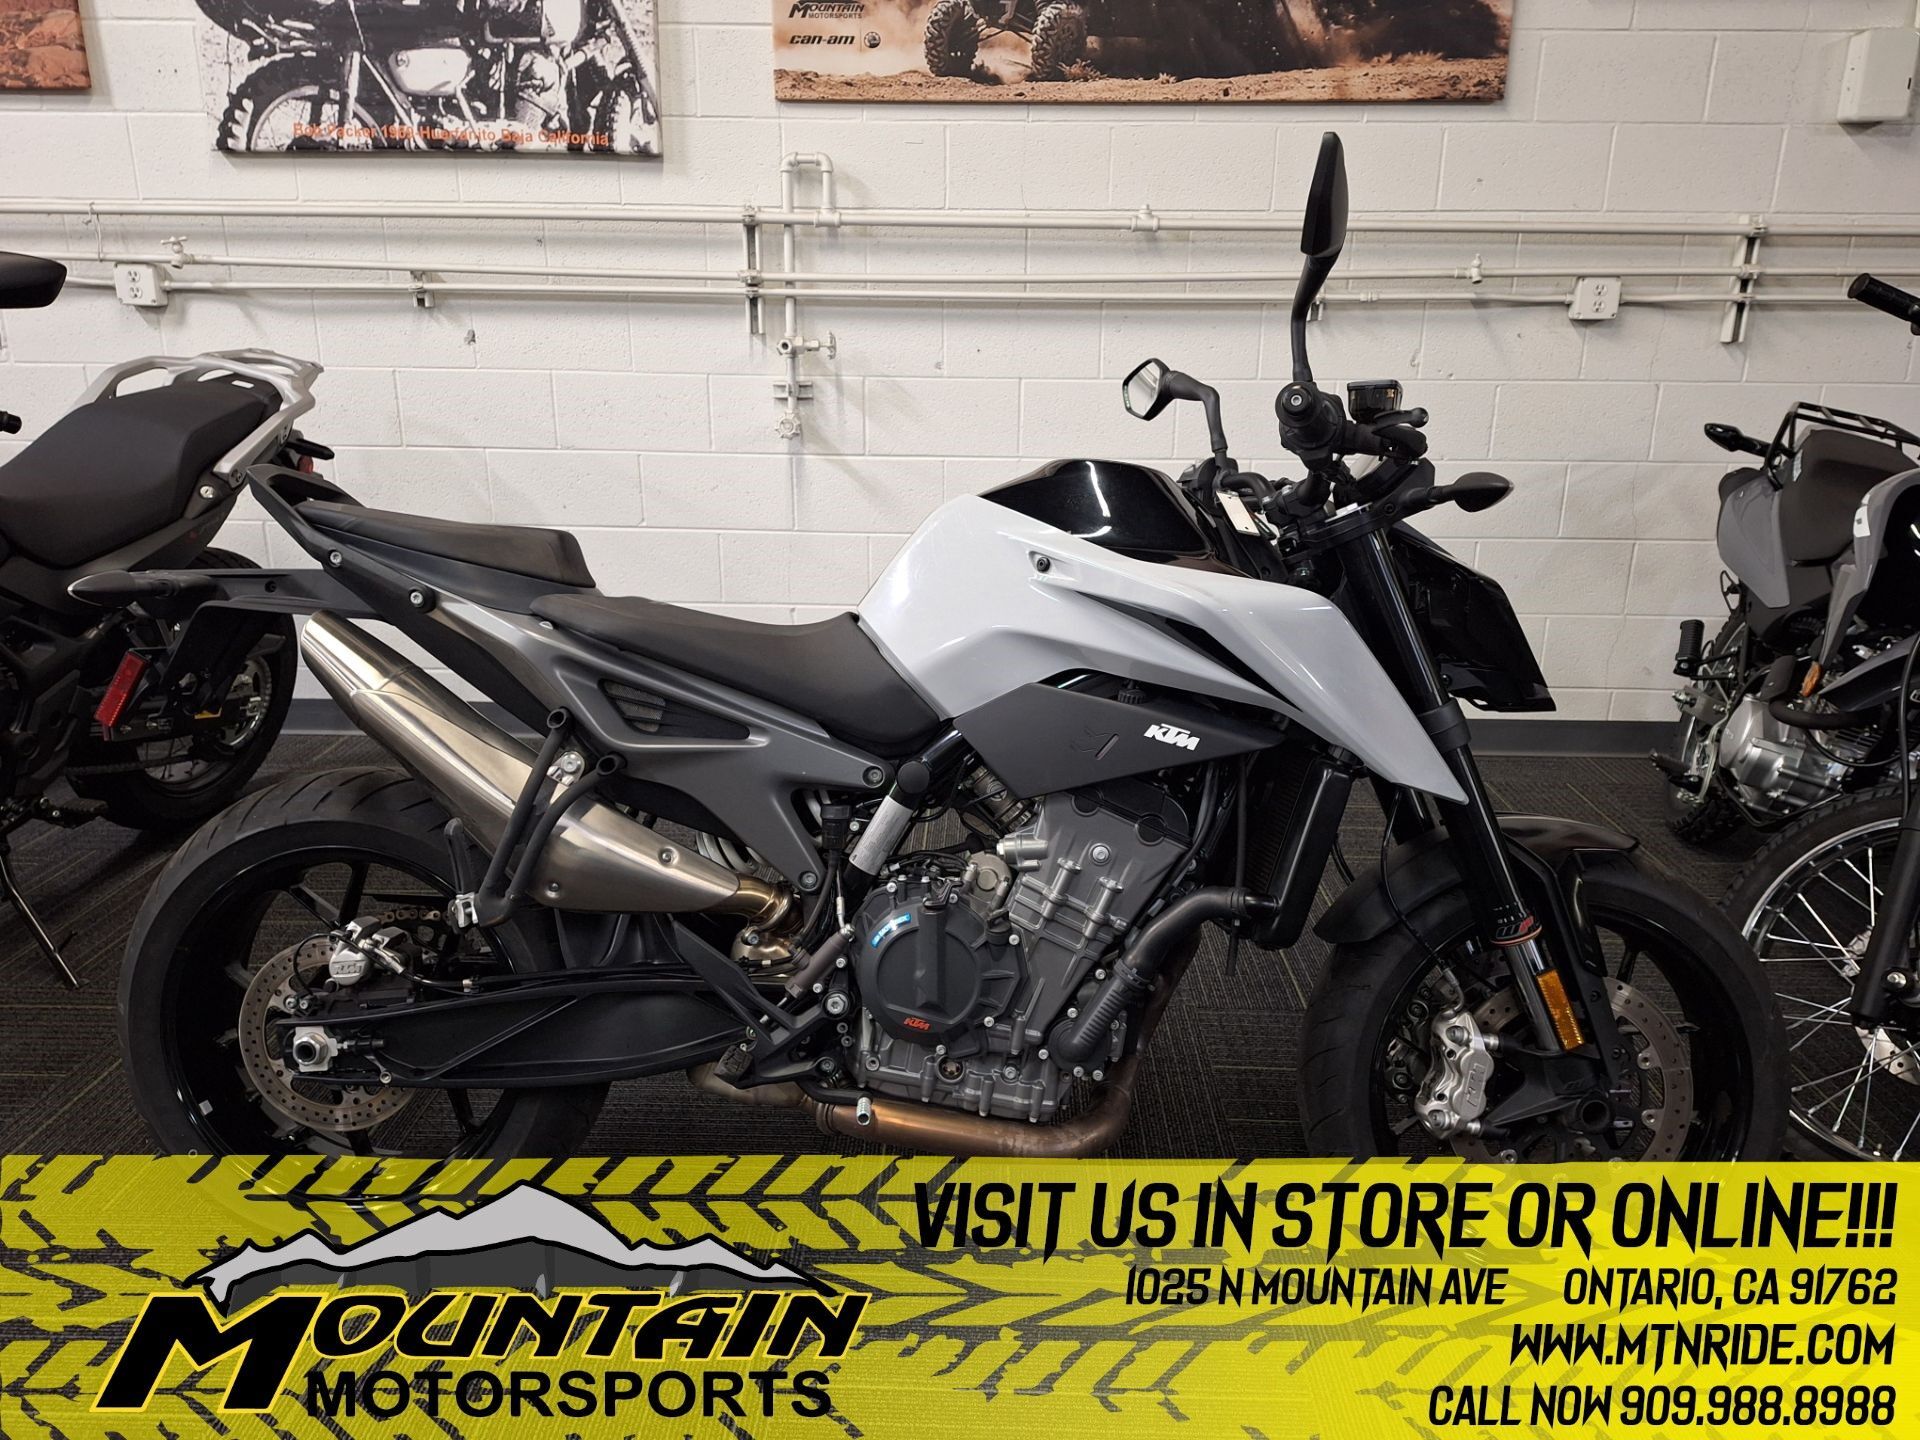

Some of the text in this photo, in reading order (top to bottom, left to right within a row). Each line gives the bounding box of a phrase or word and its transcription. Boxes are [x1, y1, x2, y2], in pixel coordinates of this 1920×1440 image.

[789, 4, 865, 18] MOUNTAIN
[789, 34, 855, 45] can-am
[293, 122, 322, 137] Bob
[501, 128, 533, 145] Baja
[538, 129, 609, 146] California
[1143, 723, 1200, 751] KTM
[903, 1016, 931, 1031] KTM
